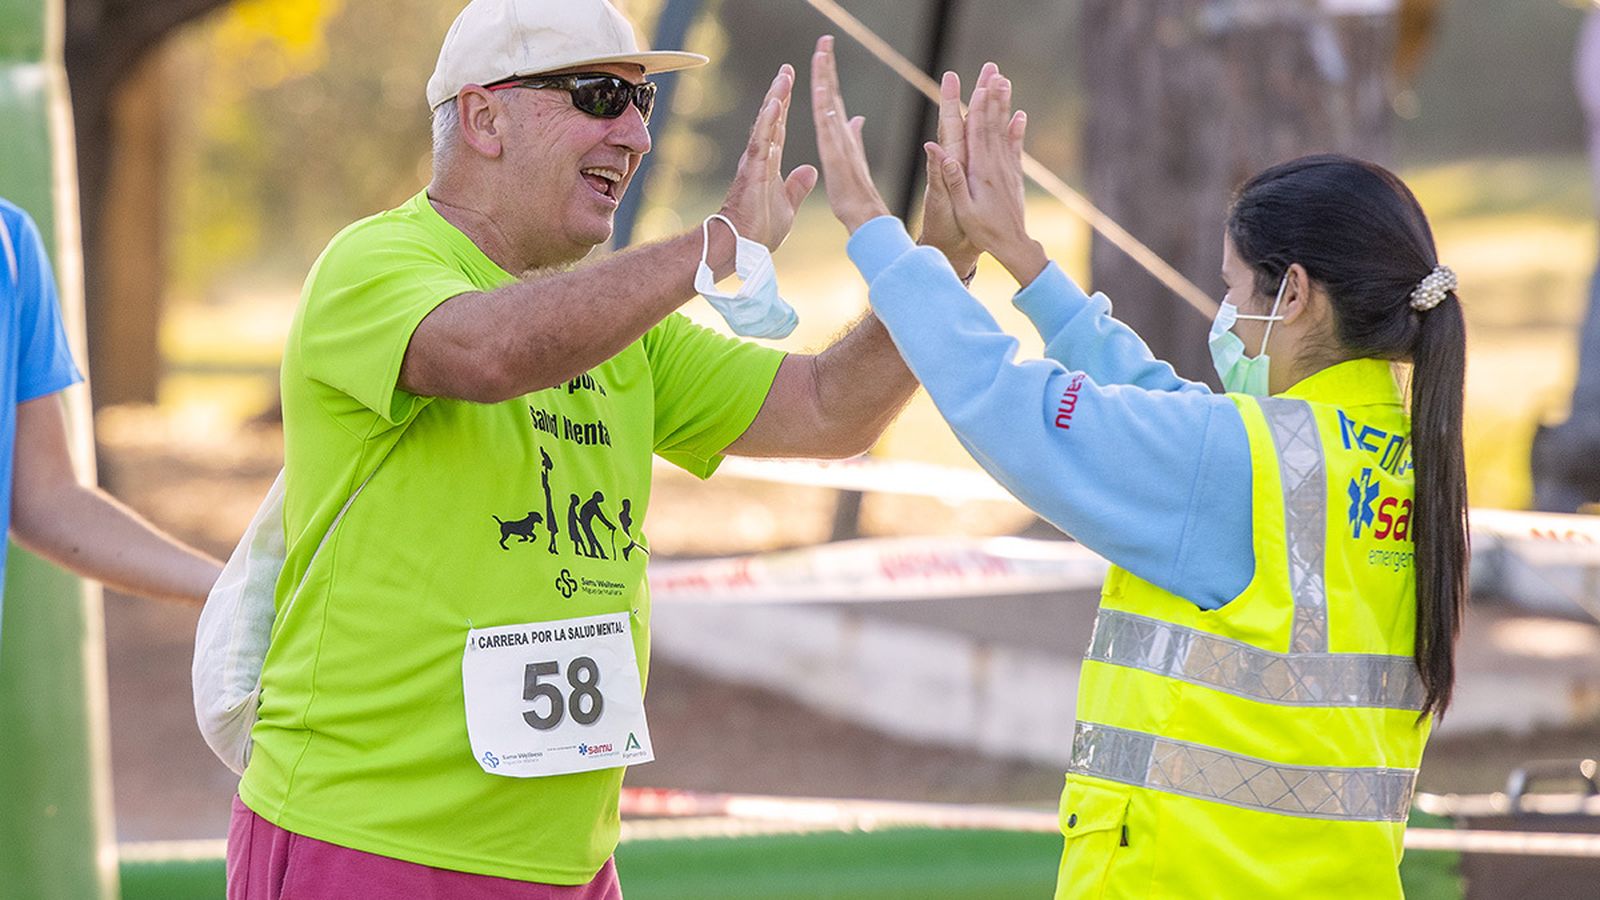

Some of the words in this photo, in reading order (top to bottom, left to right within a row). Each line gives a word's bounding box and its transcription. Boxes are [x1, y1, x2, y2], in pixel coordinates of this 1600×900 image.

[1055, 374, 1086, 430] samu
[1374, 496, 1414, 542] sa
[478, 632, 530, 649] CARRERA
[531, 629, 553, 644] POR
[553, 627, 567, 641] LA
[567, 624, 596, 640] SALUD
[596, 621, 624, 636] MENTAL
[522, 656, 605, 731] 58
[587, 743, 613, 755] samu
